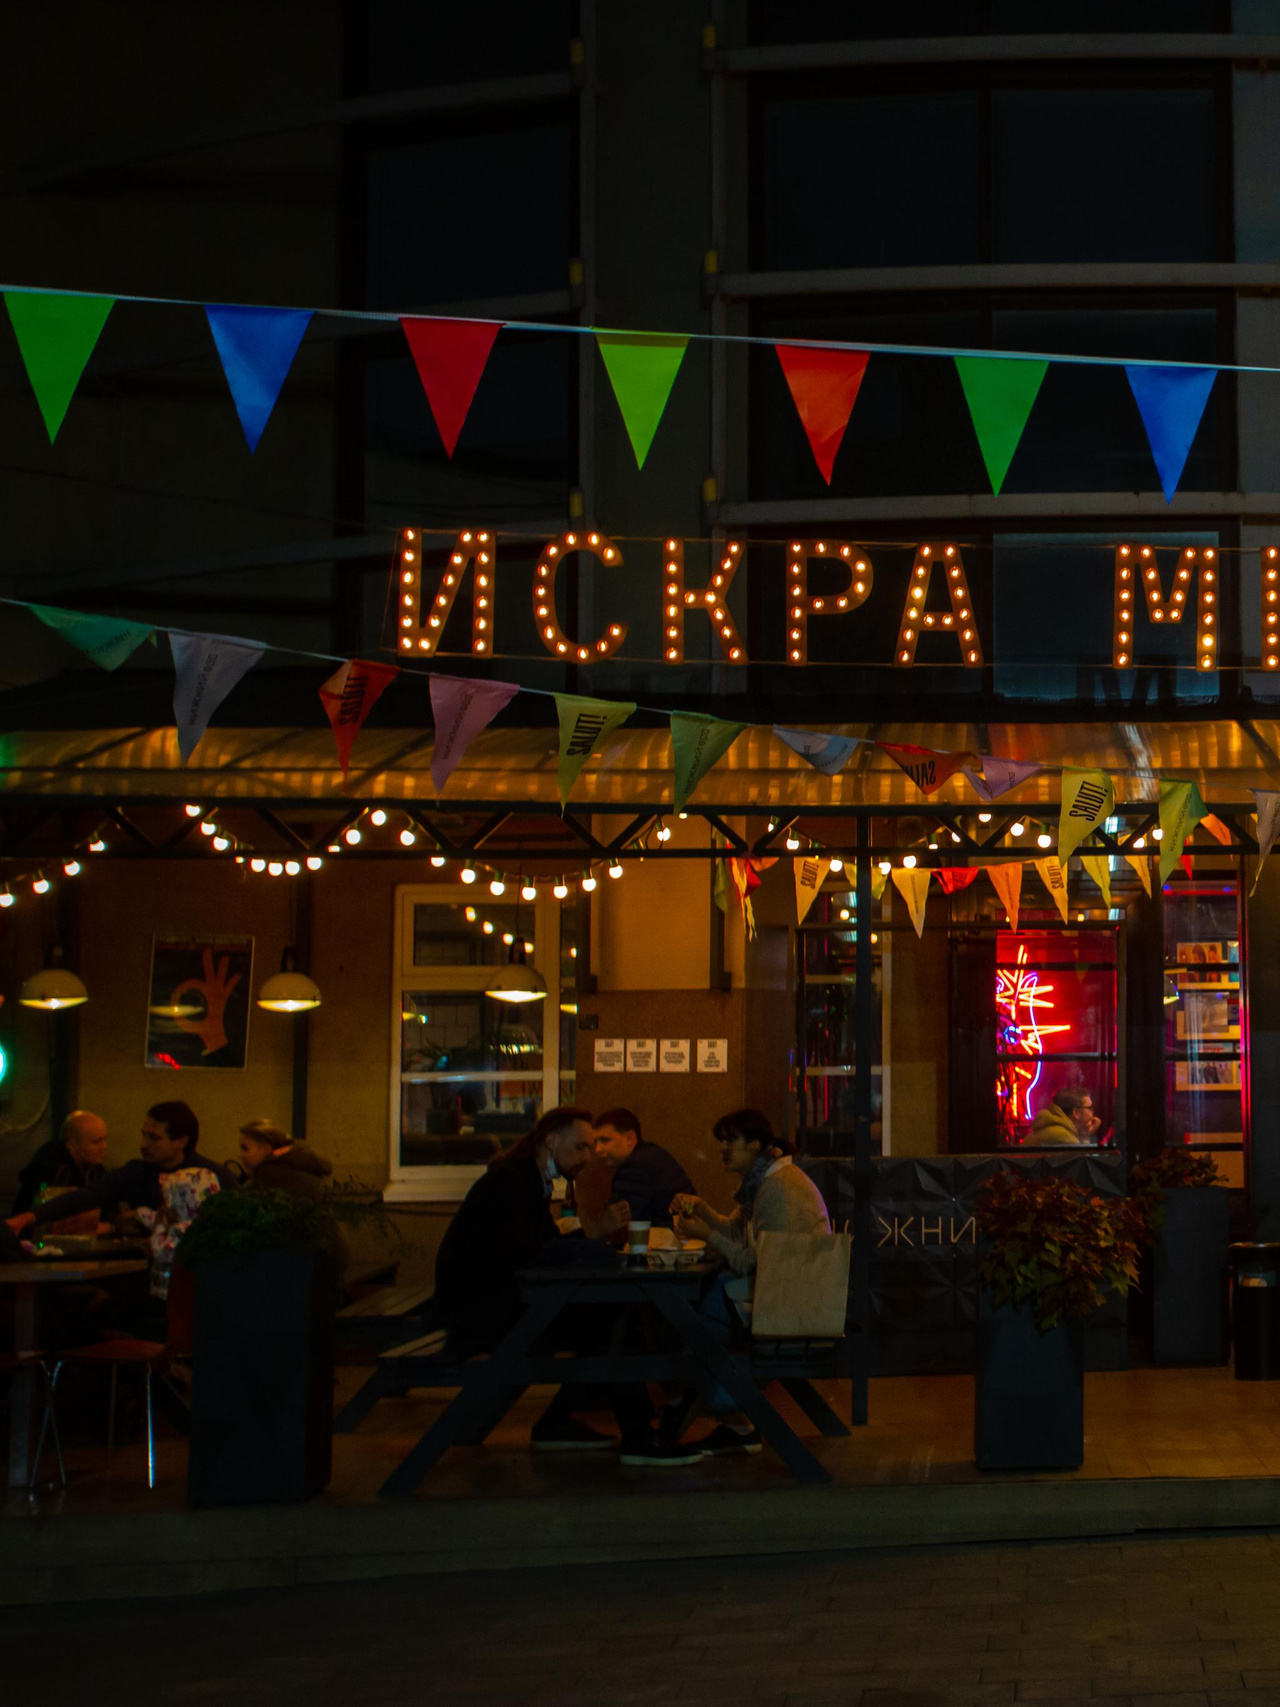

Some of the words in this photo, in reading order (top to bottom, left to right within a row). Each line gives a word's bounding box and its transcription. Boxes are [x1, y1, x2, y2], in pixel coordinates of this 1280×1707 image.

[397, 526, 985, 668] ИСКРА
[566, 713, 607, 756] SALUT!
[1069, 780, 1109, 821] SALUT!
[832, 1216, 977, 1249] ЖНИ
